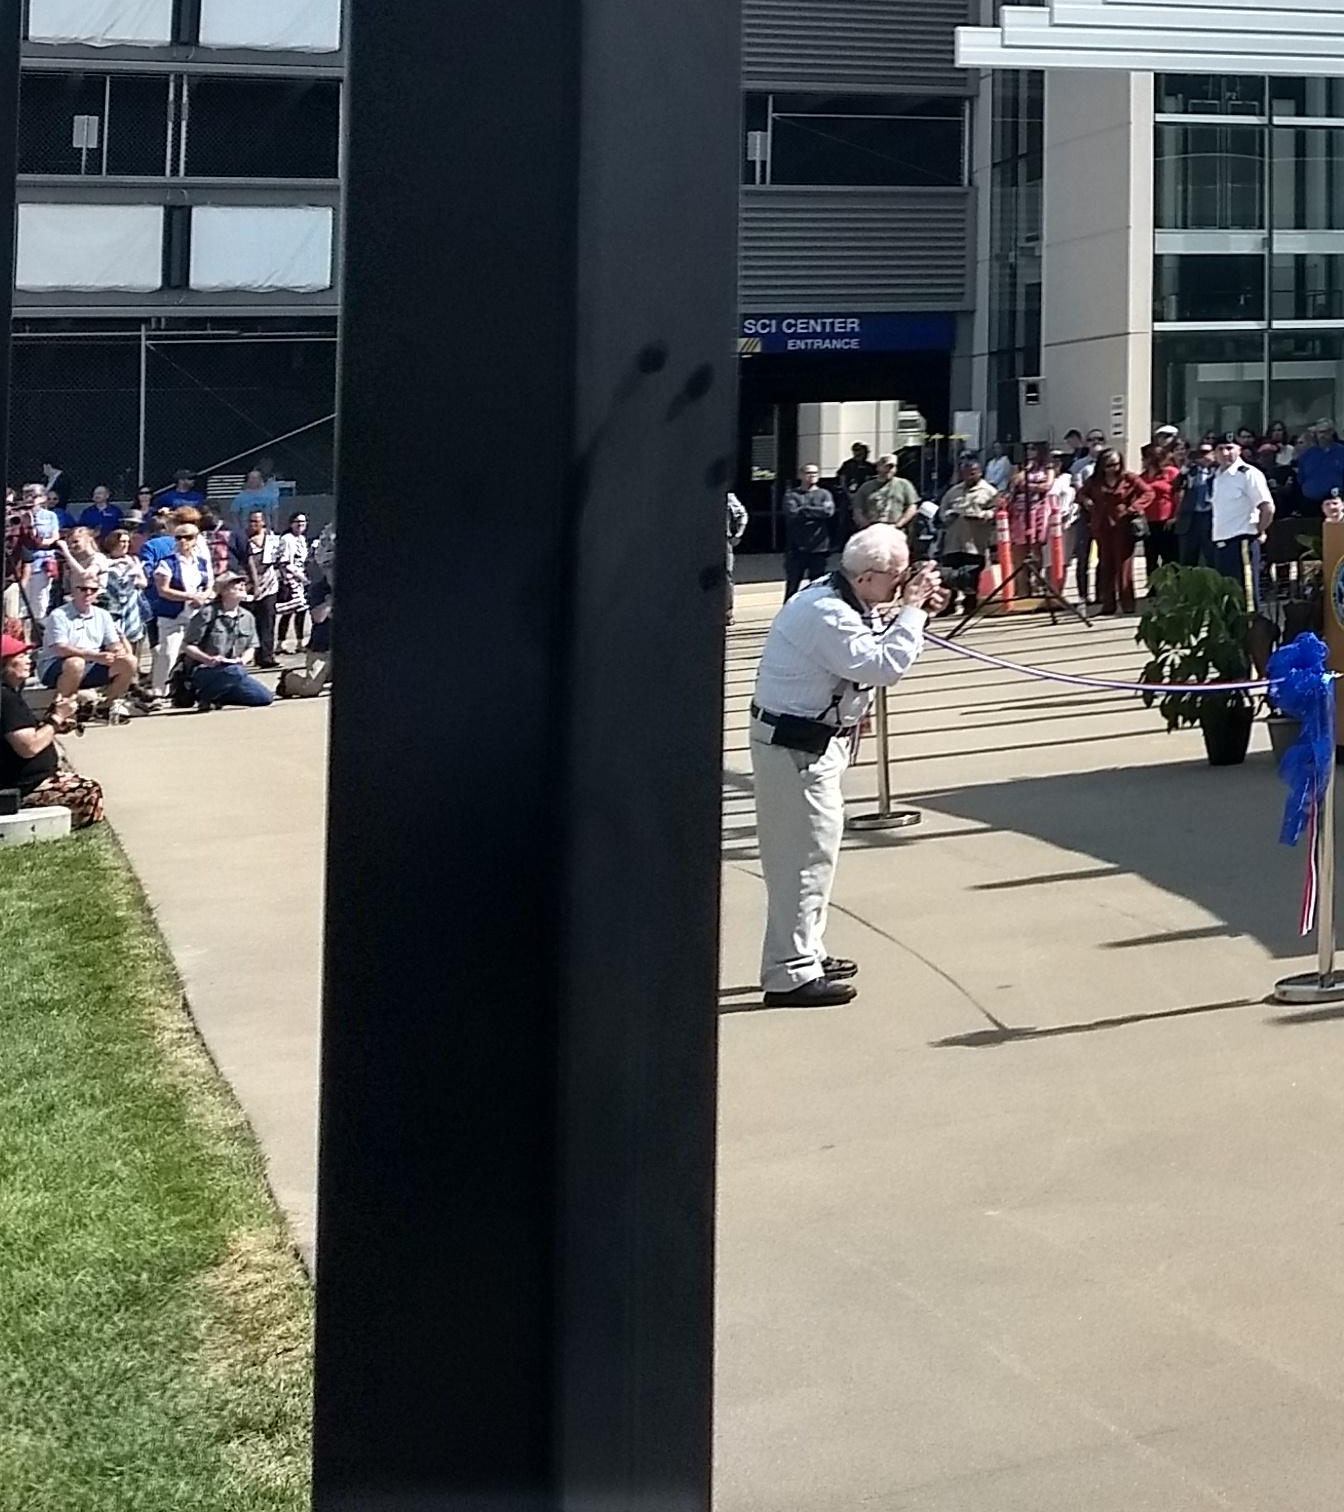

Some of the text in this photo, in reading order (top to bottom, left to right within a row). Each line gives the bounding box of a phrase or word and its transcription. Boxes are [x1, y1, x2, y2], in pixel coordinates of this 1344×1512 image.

[743, 318, 860, 334] SCI CENTER
[787, 339, 860, 350] ENTRANCE
